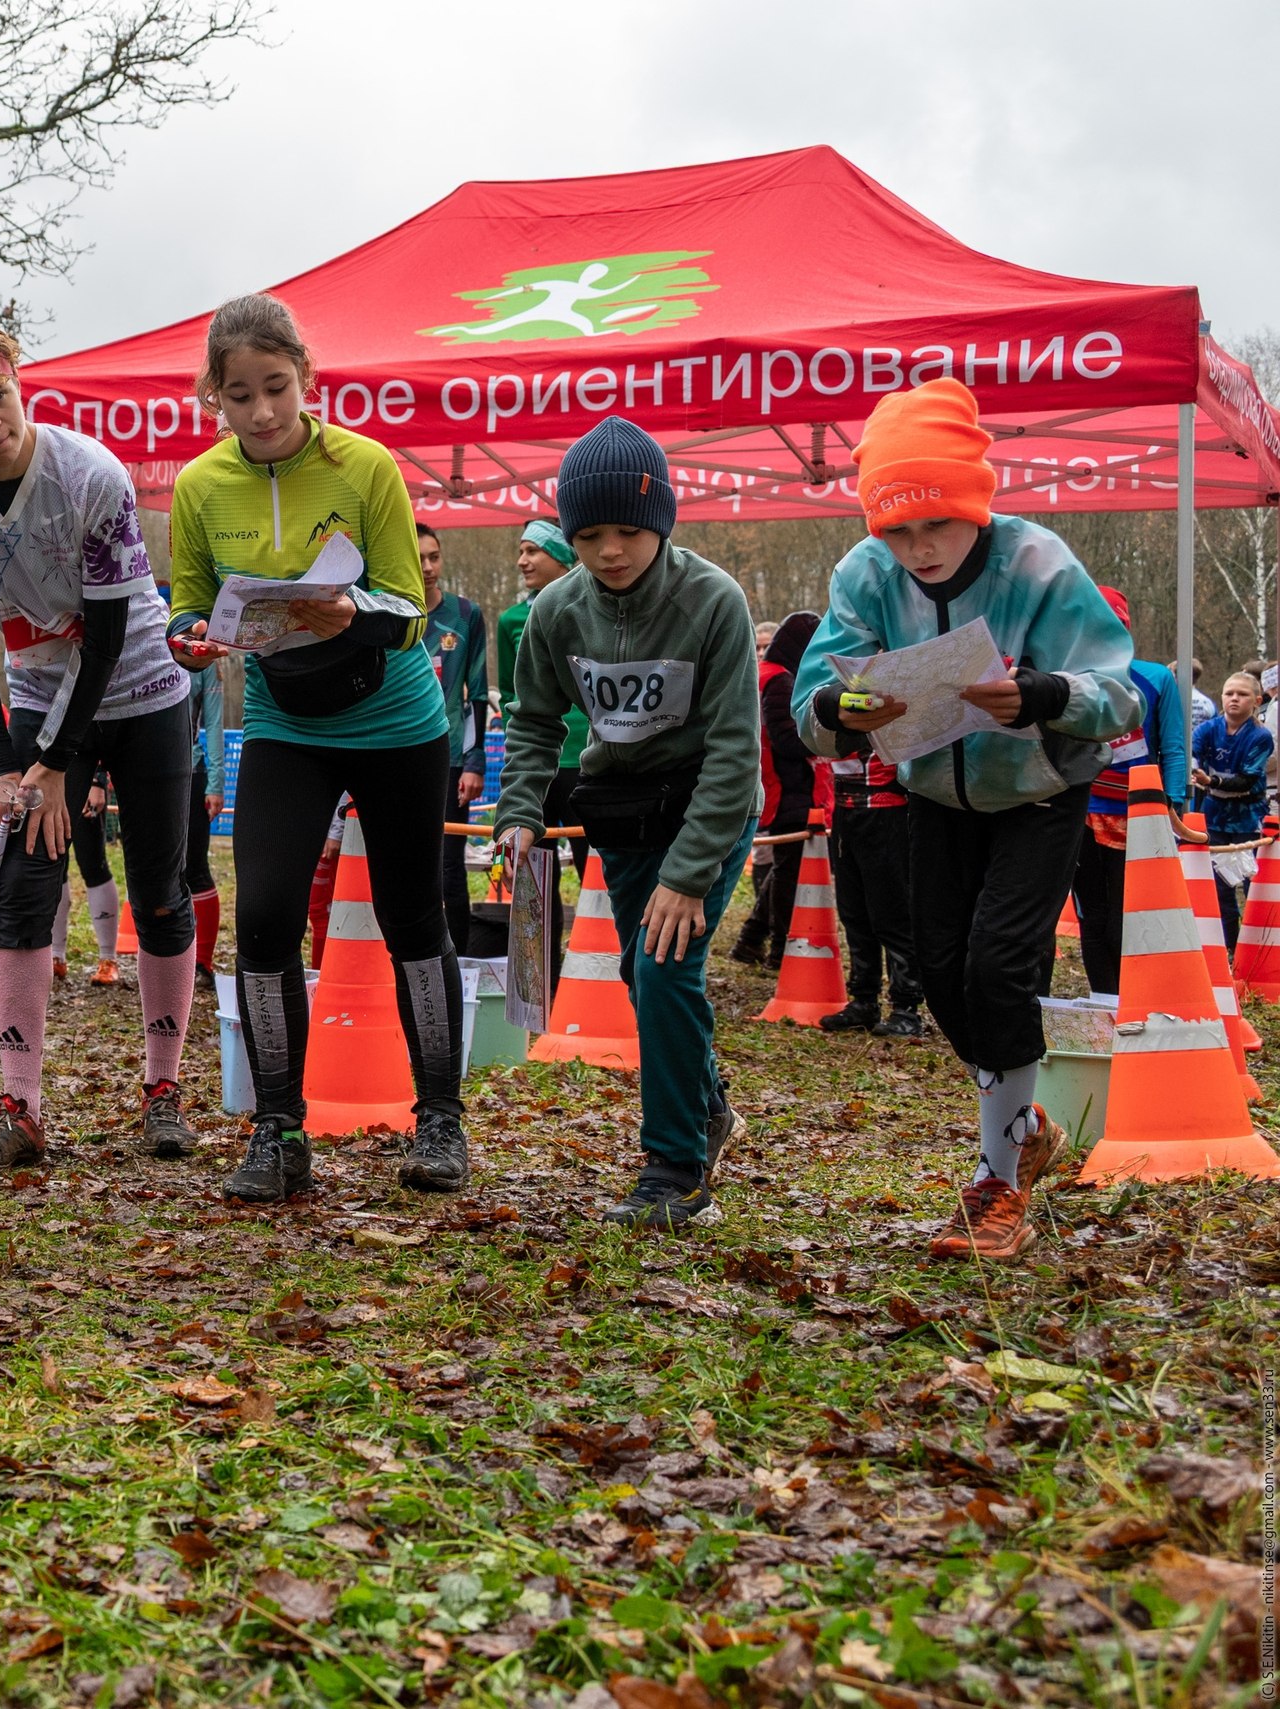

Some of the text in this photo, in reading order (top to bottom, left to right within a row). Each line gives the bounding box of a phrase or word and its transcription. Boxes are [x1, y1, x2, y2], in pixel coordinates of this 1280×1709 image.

[26, 331, 1123, 453] Спортное ориентирование
[130, 670, 181, 699] 1:25000
[583, 671, 665, 713] 3028
[650, 714, 681, 724] ОБЛАСТЬ
